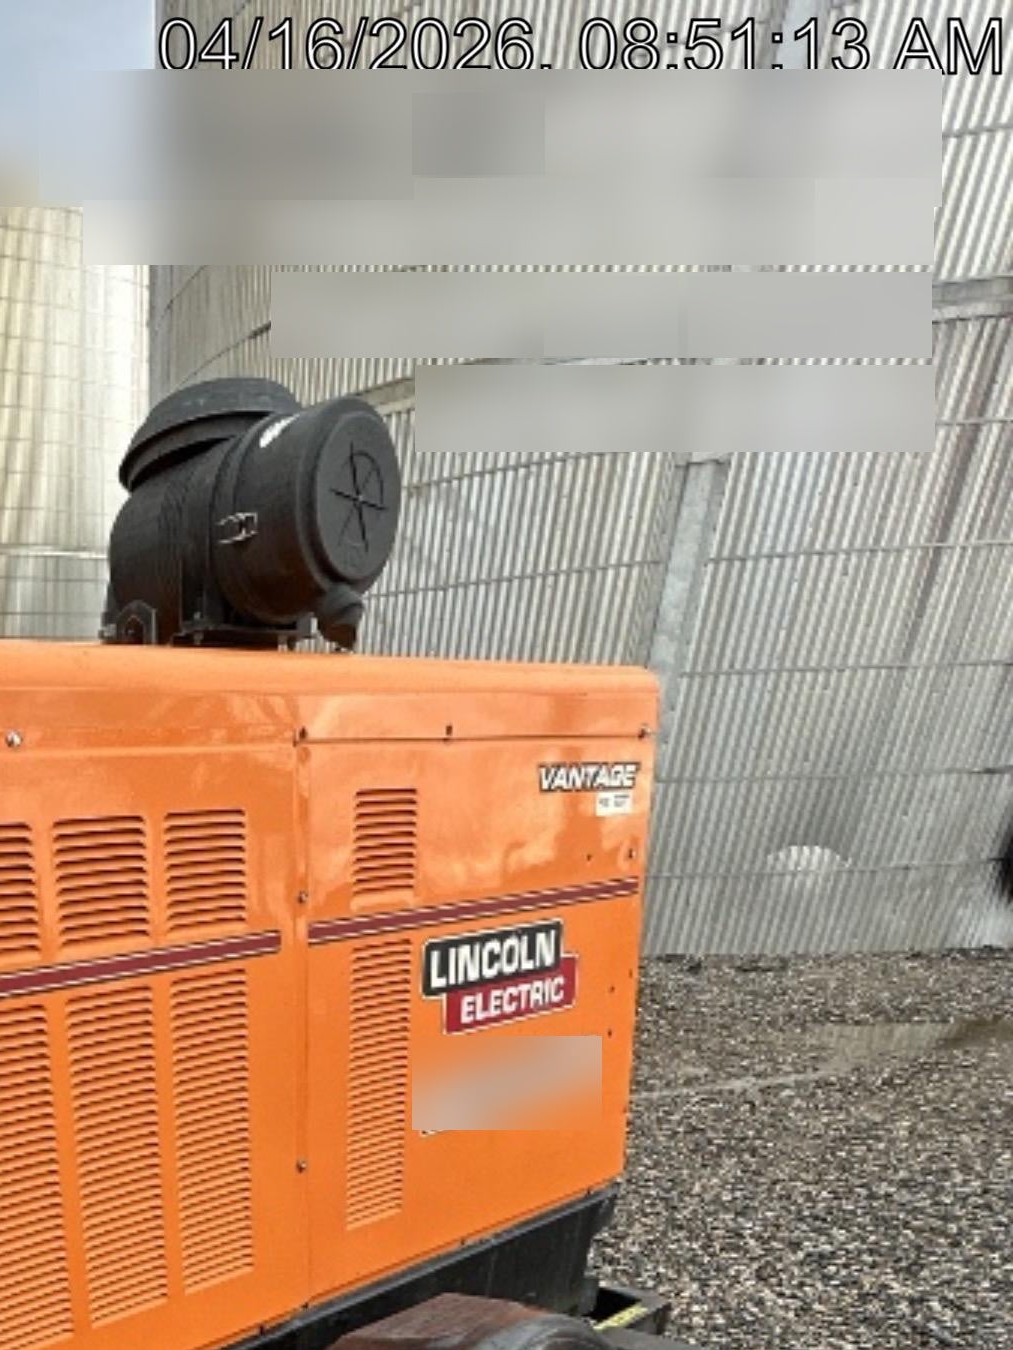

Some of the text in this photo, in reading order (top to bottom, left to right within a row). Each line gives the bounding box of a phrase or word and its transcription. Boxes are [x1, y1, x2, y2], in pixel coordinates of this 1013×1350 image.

[539, 763, 638, 791] VANTAGE
[430, 929, 556, 989] LINCOLN
[460, 975, 565, 1024] ELECTRIC
